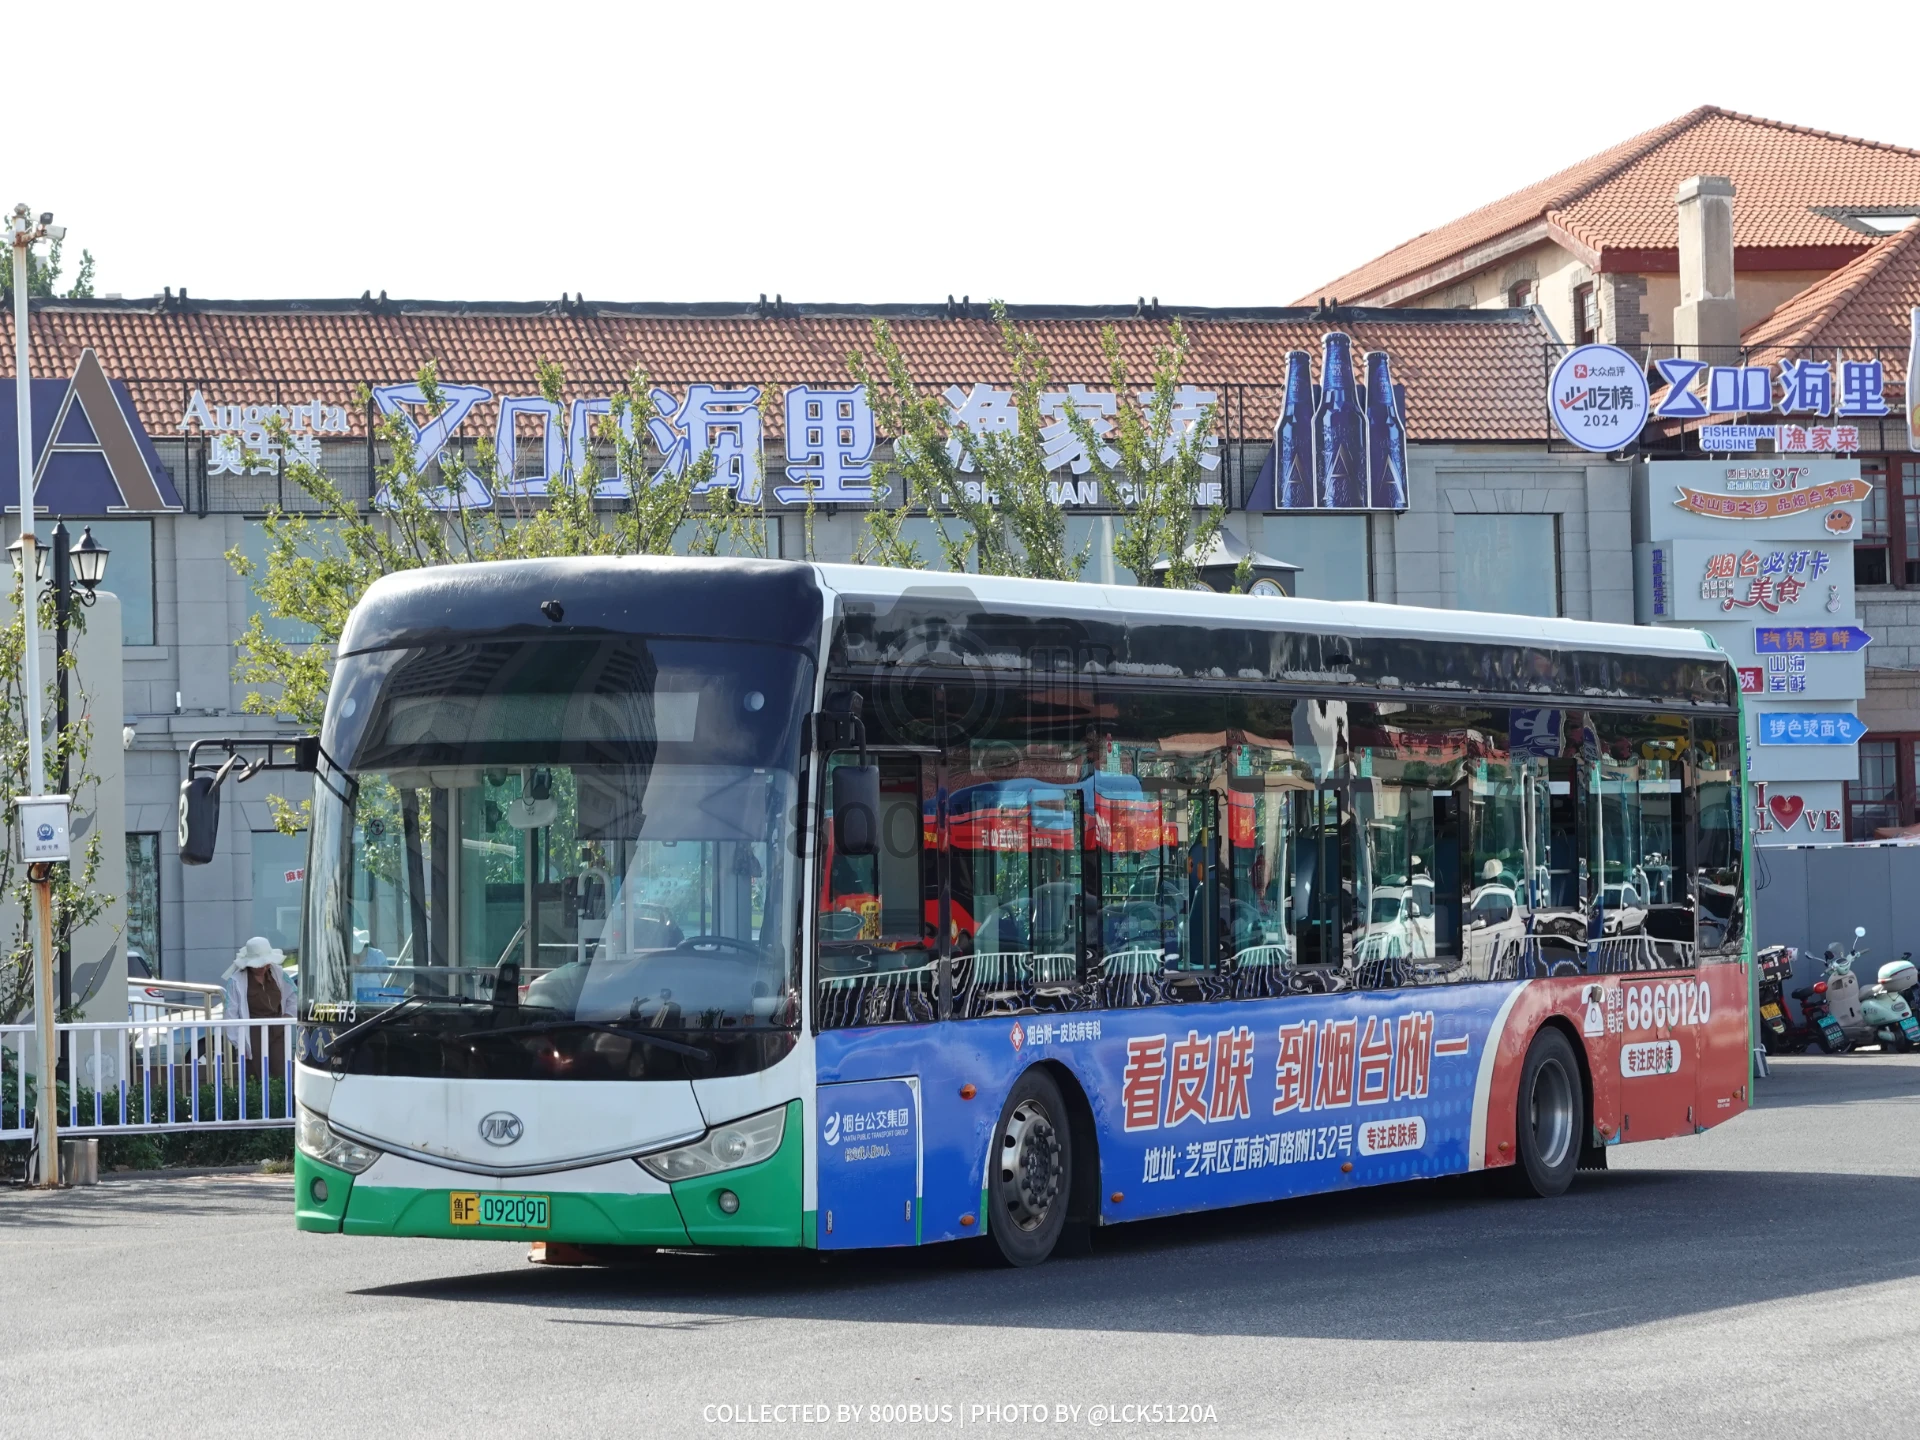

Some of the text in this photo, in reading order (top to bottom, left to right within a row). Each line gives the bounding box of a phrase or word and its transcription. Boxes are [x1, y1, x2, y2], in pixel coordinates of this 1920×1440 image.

[1588, 366, 1626, 377] 大众点评
[1560, 385, 1634, 411] 必吃榜
[177, 389, 350, 444] Augerta
[1583, 414, 1619, 427] 2024
[1702, 426, 1776, 438] FISHERMAN
[1703, 438, 1756, 450] CUISINE
[1787, 427, 1859, 451] 漁家菜
[207, 433, 323, 477] 奥古特
[1690, 494, 1769, 515] 赴山海之约
[1777, 483, 1856, 511] 品烟台本鲜
[1705, 549, 1831, 581] 烟台必打卡
[1722, 576, 1807, 614] 美食
[1763, 630, 1850, 650] 汽锅海鲜
[1768, 654, 1806, 673] 山海
[1769, 674, 1807, 692] 至鲜
[1769, 719, 1852, 738] 特色烫面包
[1607, 987, 1624, 1010] 咨询
[1626, 981, 1711, 1031] 6860120
[1026, 1020, 1102, 1045] 烟台附一皮肤病专科
[1607, 1011, 1624, 1034] 电话
[1123, 1010, 1471, 1133] 看皮肤 到烟台附一
[1628, 1046, 1674, 1073] 专注皮肤病
[842, 1108, 909, 1134] 烟台公交集团
[857, 1132, 871, 1141] PUBLIC
[871, 1130, 895, 1139] TRANSPORT
[894, 1129, 909, 1137] GROUP
[1366, 1121, 1418, 1151] 专注皮肤病
